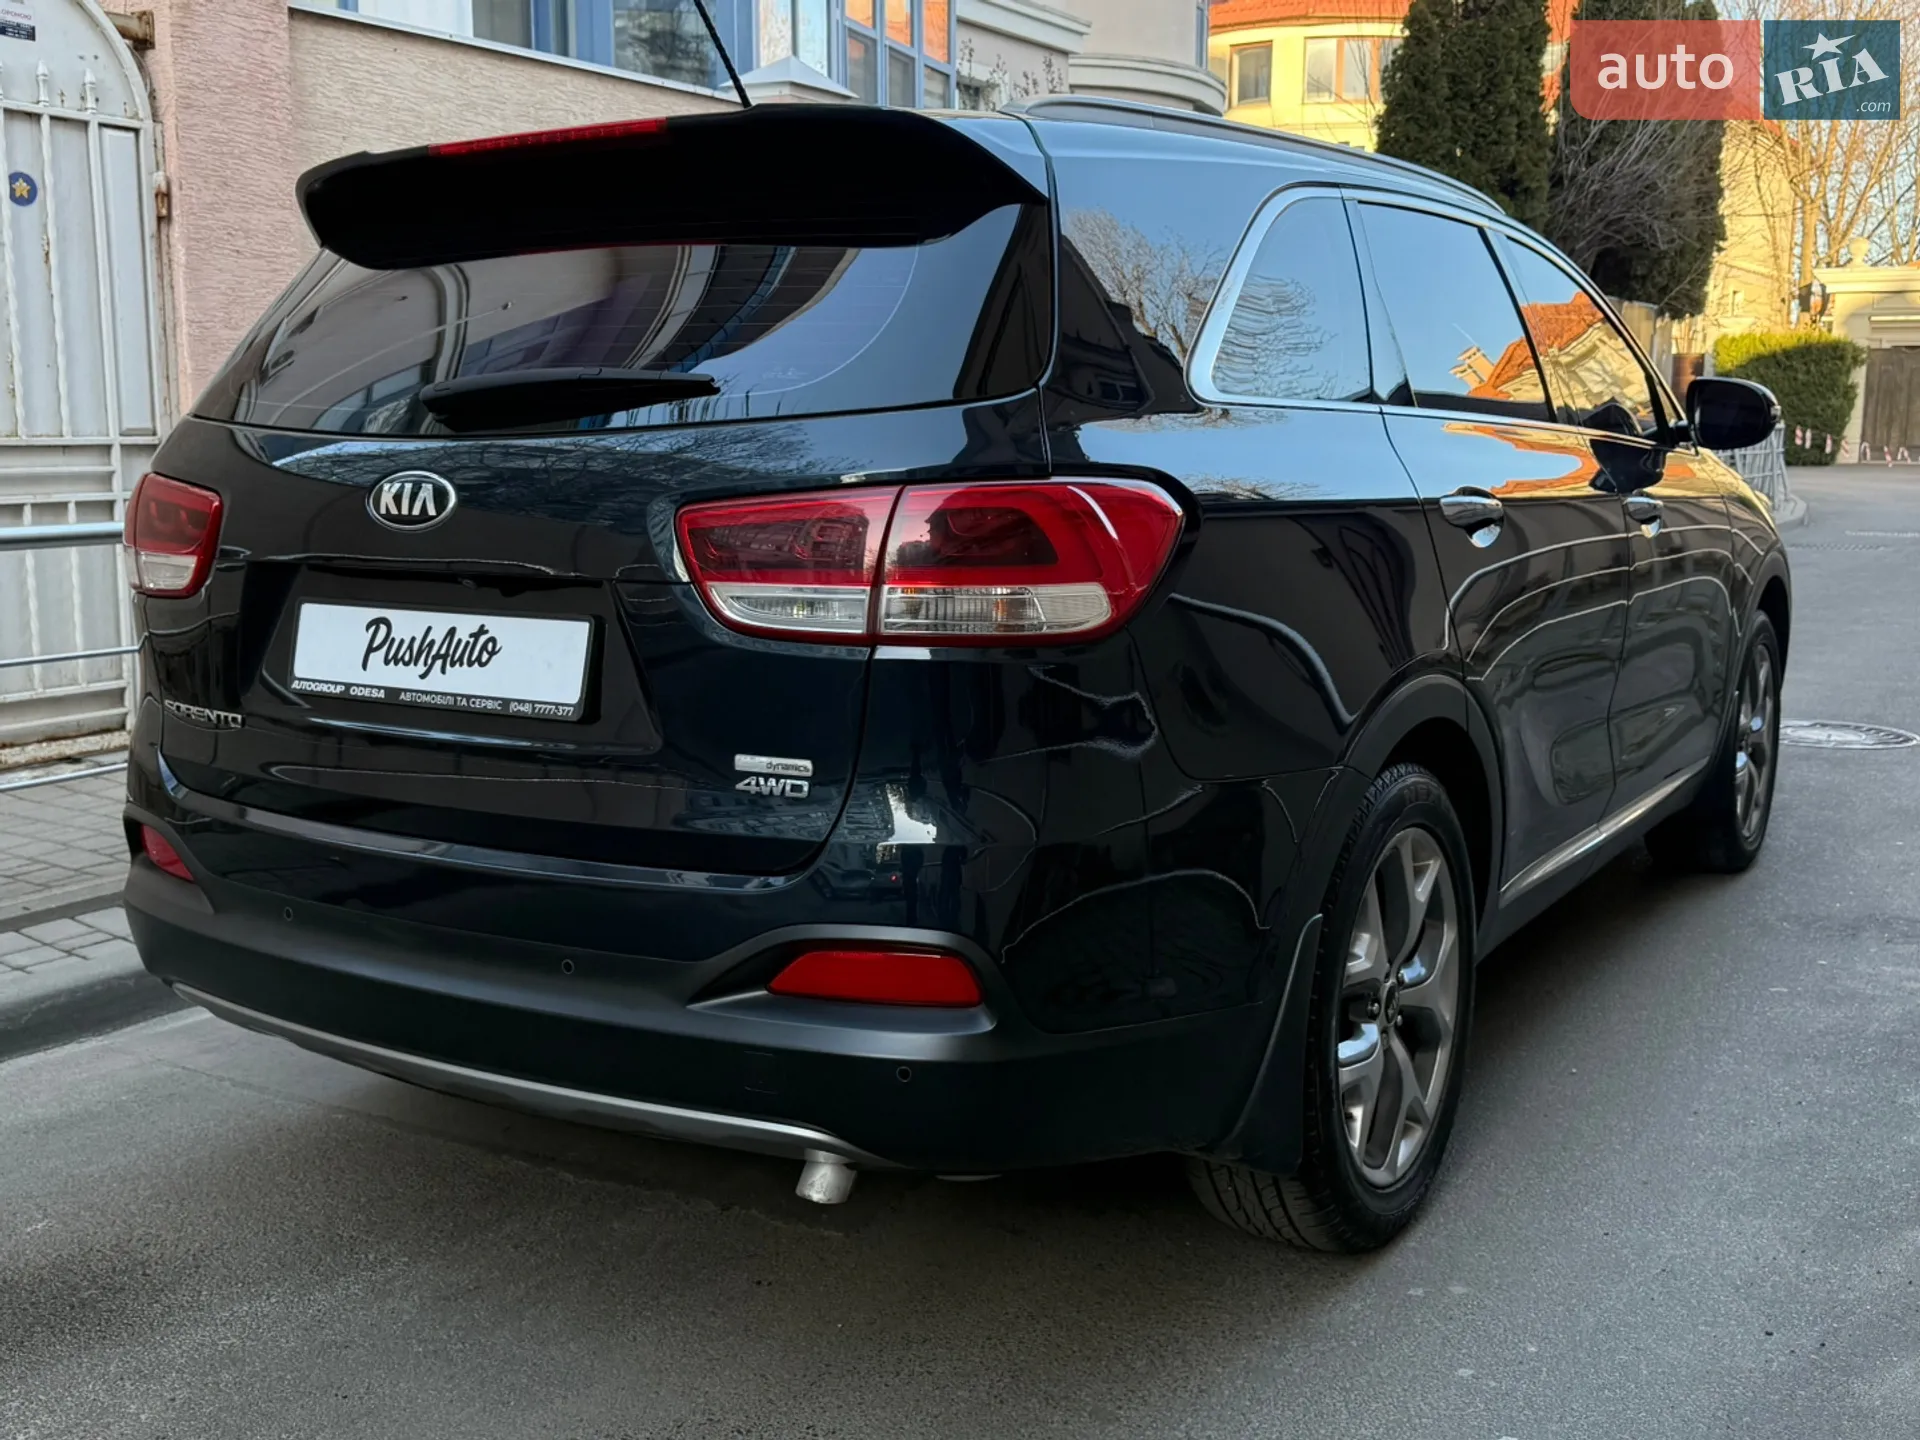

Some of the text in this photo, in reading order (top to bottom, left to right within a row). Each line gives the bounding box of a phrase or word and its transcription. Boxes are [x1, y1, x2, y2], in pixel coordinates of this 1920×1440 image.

[379, 483, 437, 516] KIA
[361, 616, 502, 680] PushAuto
[291, 680, 385, 698] AUTOGROUP ODESA
[399, 691, 503, 710] АВТОМОБІЛІ ТА СЕРВІС
[509, 701, 574, 716] (048) 7777-377
[164, 699, 242, 728] SORENTO
[766, 761, 810, 772] dynamics
[735, 776, 809, 798] 4WD
